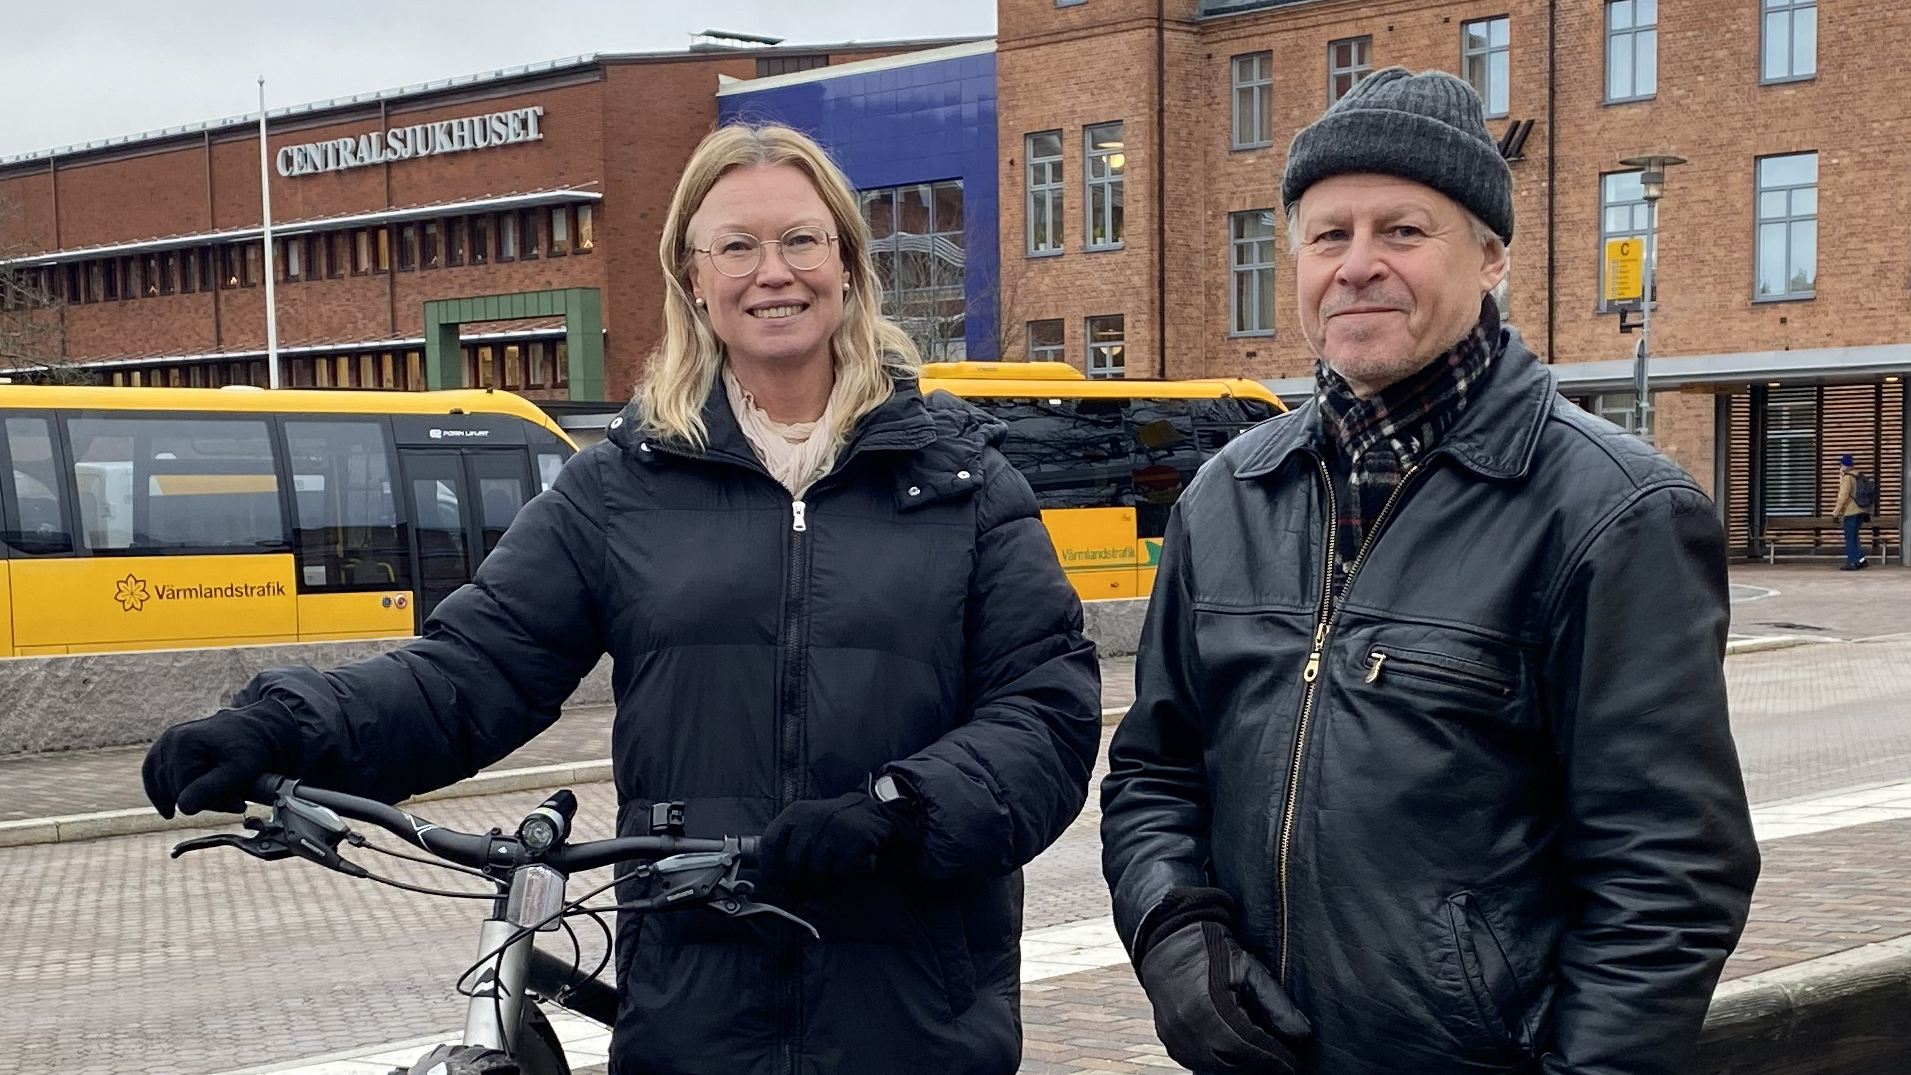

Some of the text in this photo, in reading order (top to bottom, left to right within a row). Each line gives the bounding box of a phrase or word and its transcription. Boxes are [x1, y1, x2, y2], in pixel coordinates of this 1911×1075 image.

[276, 106, 544, 177] CENTRALSJUKHUSET
[1620, 242, 1630, 256] C
[1062, 546, 1135, 561] Värmlandstrafik
[155, 581, 286, 600] Värmlandstrafik
